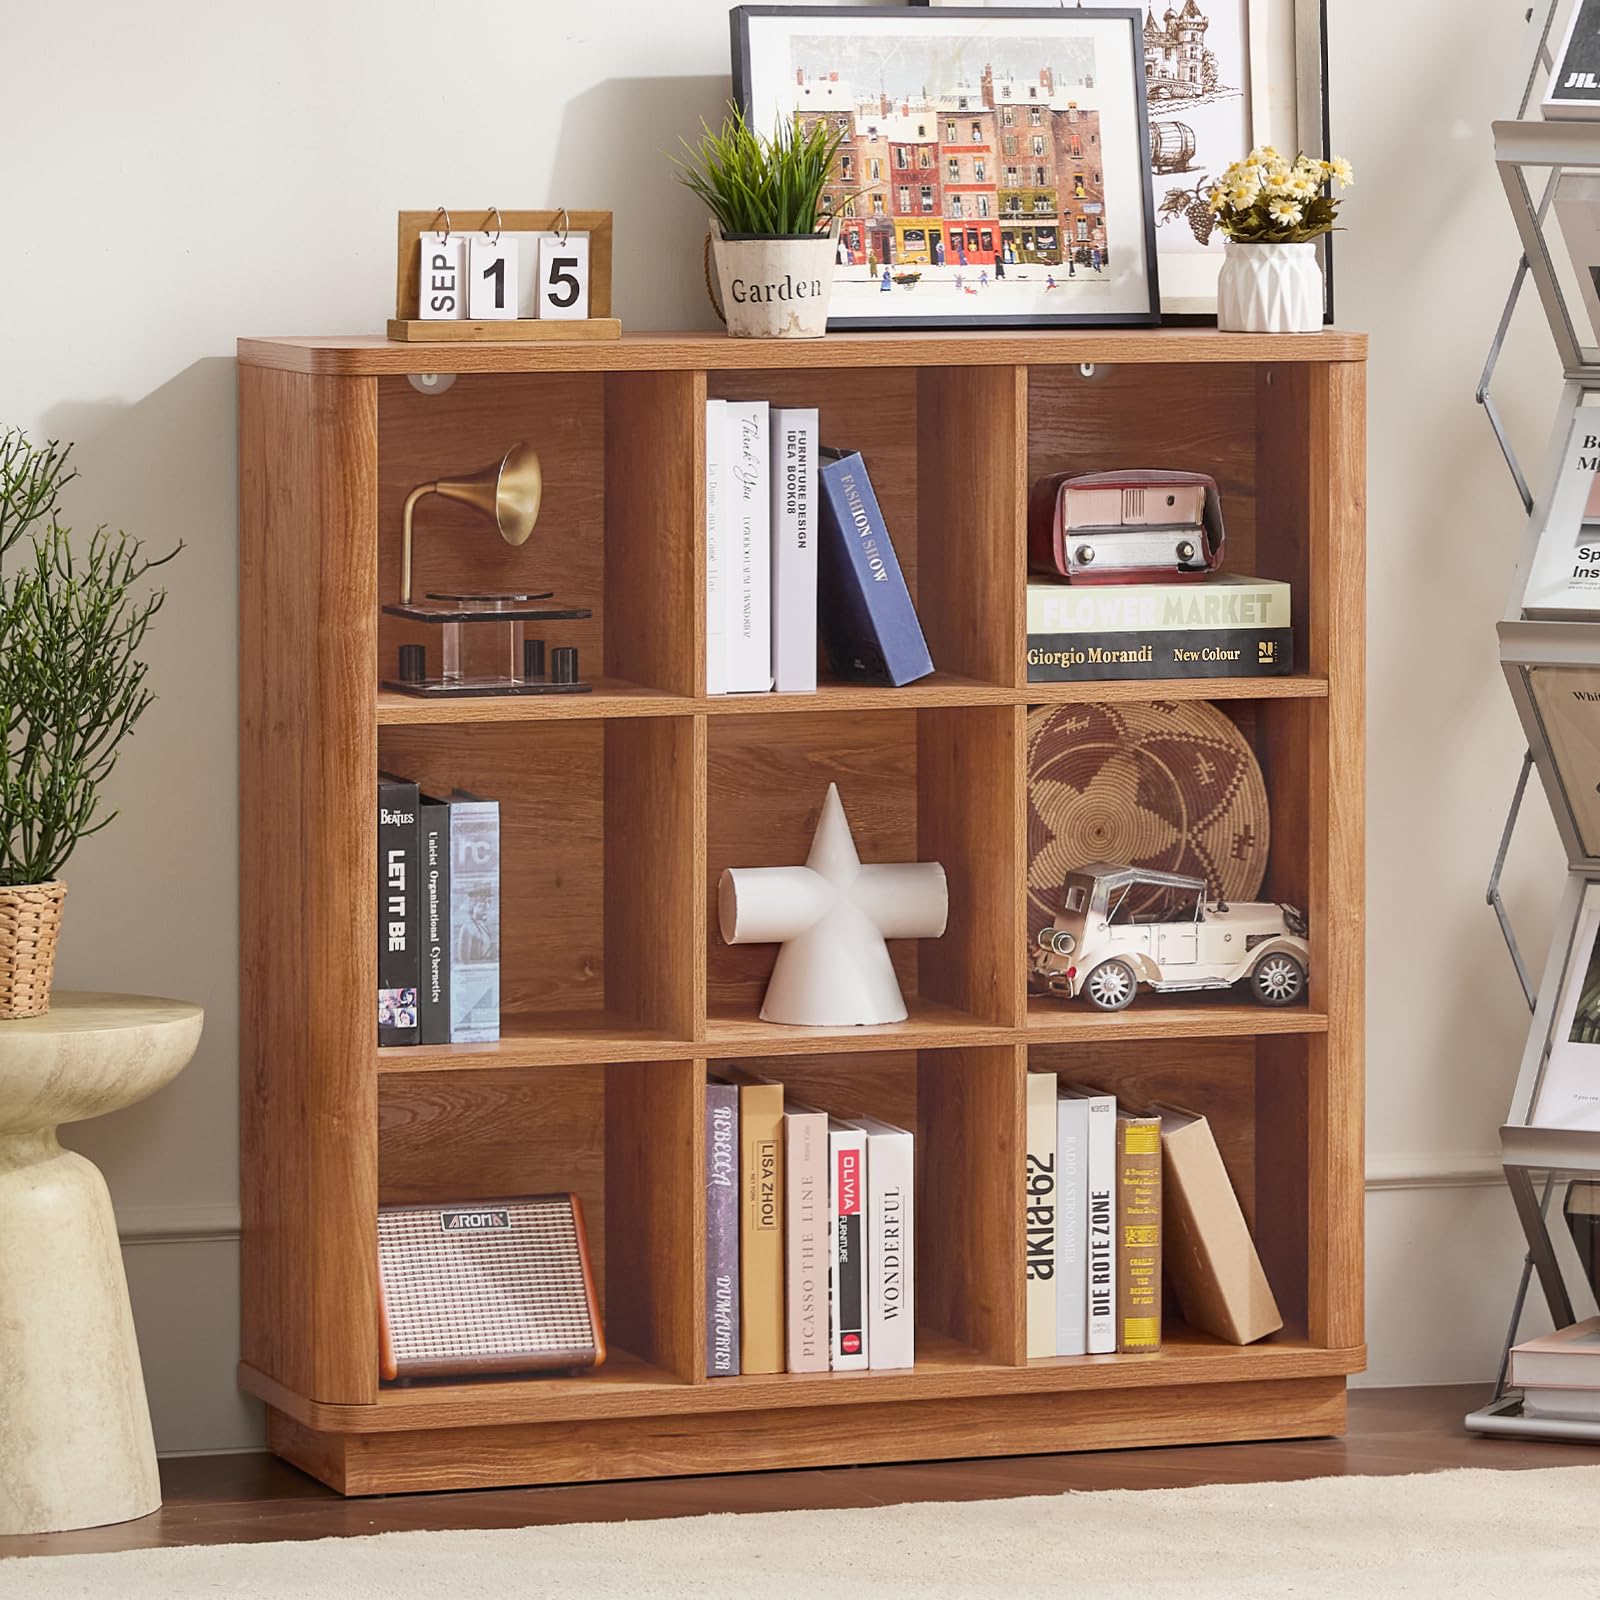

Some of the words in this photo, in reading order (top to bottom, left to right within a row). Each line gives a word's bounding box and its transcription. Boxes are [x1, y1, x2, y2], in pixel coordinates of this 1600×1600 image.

[1564, 72, 1600, 88] JIL
[430, 254, 456, 312] SEP
[483, 258, 505, 309] 1
[548, 257, 580, 308] 5
[731, 275, 822, 303] Garden
[741, 414, 760, 463] Thank
[787, 430, 796, 459] IDEA
[733, 464, 759, 502] You
[797, 430, 807, 500] FURNITURE
[787, 465, 796, 514] BOOK08
[797, 504, 807, 549] DESIGN
[841, 474, 872, 537] FASHION
[862, 539, 889, 583] SHOW
[1572, 565, 1600, 578] Ins
[1043, 595, 1155, 628] FLOWER
[1162, 593, 1273, 625] MARKET
[1027, 647, 1085, 668] Giorgio
[1088, 645, 1153, 664] Morandi
[1173, 648, 1200, 661] New
[1201, 647, 1241, 662] Colour
[388, 849, 406, 890] LET
[388, 896, 406, 916] IT
[429, 871, 440, 942] Organizational
[388, 921, 406, 952] BE
[431, 947, 442, 1003] Cybernetics
[712, 1106, 732, 1187] REBECCA
[762, 1144, 774, 1179] LISA
[762, 1183, 774, 1225] ZHOU
[802, 1175, 814, 1223] LINE
[843, 1156, 855, 1210] OLIVIA
[448, 1213, 504, 1228] AROMA
[1092, 1190, 1110, 1236] ZONE
[802, 1232, 814, 1273] THE
[840, 1215, 848, 1263] FURNITURE
[884, 1186, 899, 1321] WONDERFUL
[1092, 1240, 1110, 1285] ROTE
[802, 1280, 815, 1357] PICASSO
[1092, 1288, 1110, 1316] DIE
